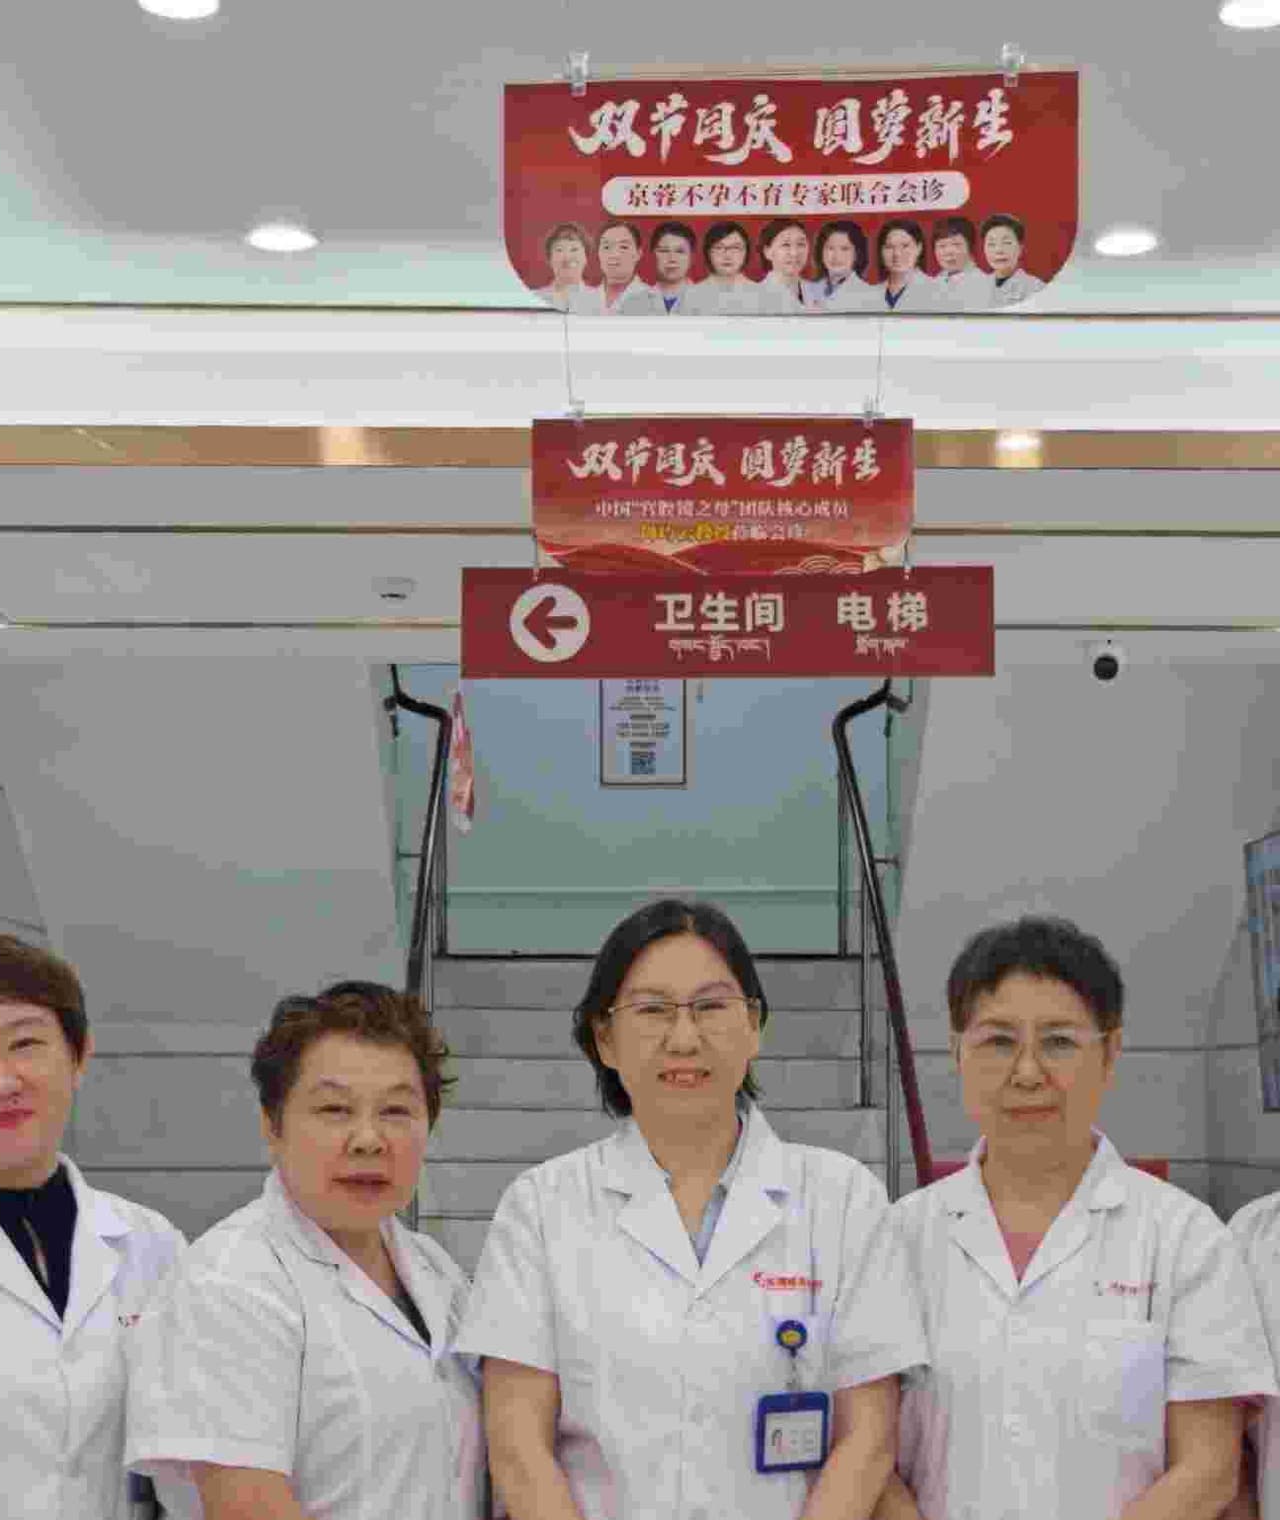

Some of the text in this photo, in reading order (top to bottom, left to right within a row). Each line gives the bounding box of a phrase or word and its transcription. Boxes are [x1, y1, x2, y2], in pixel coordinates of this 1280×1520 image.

[653, 591, 929, 632] 卫生间 电梯
